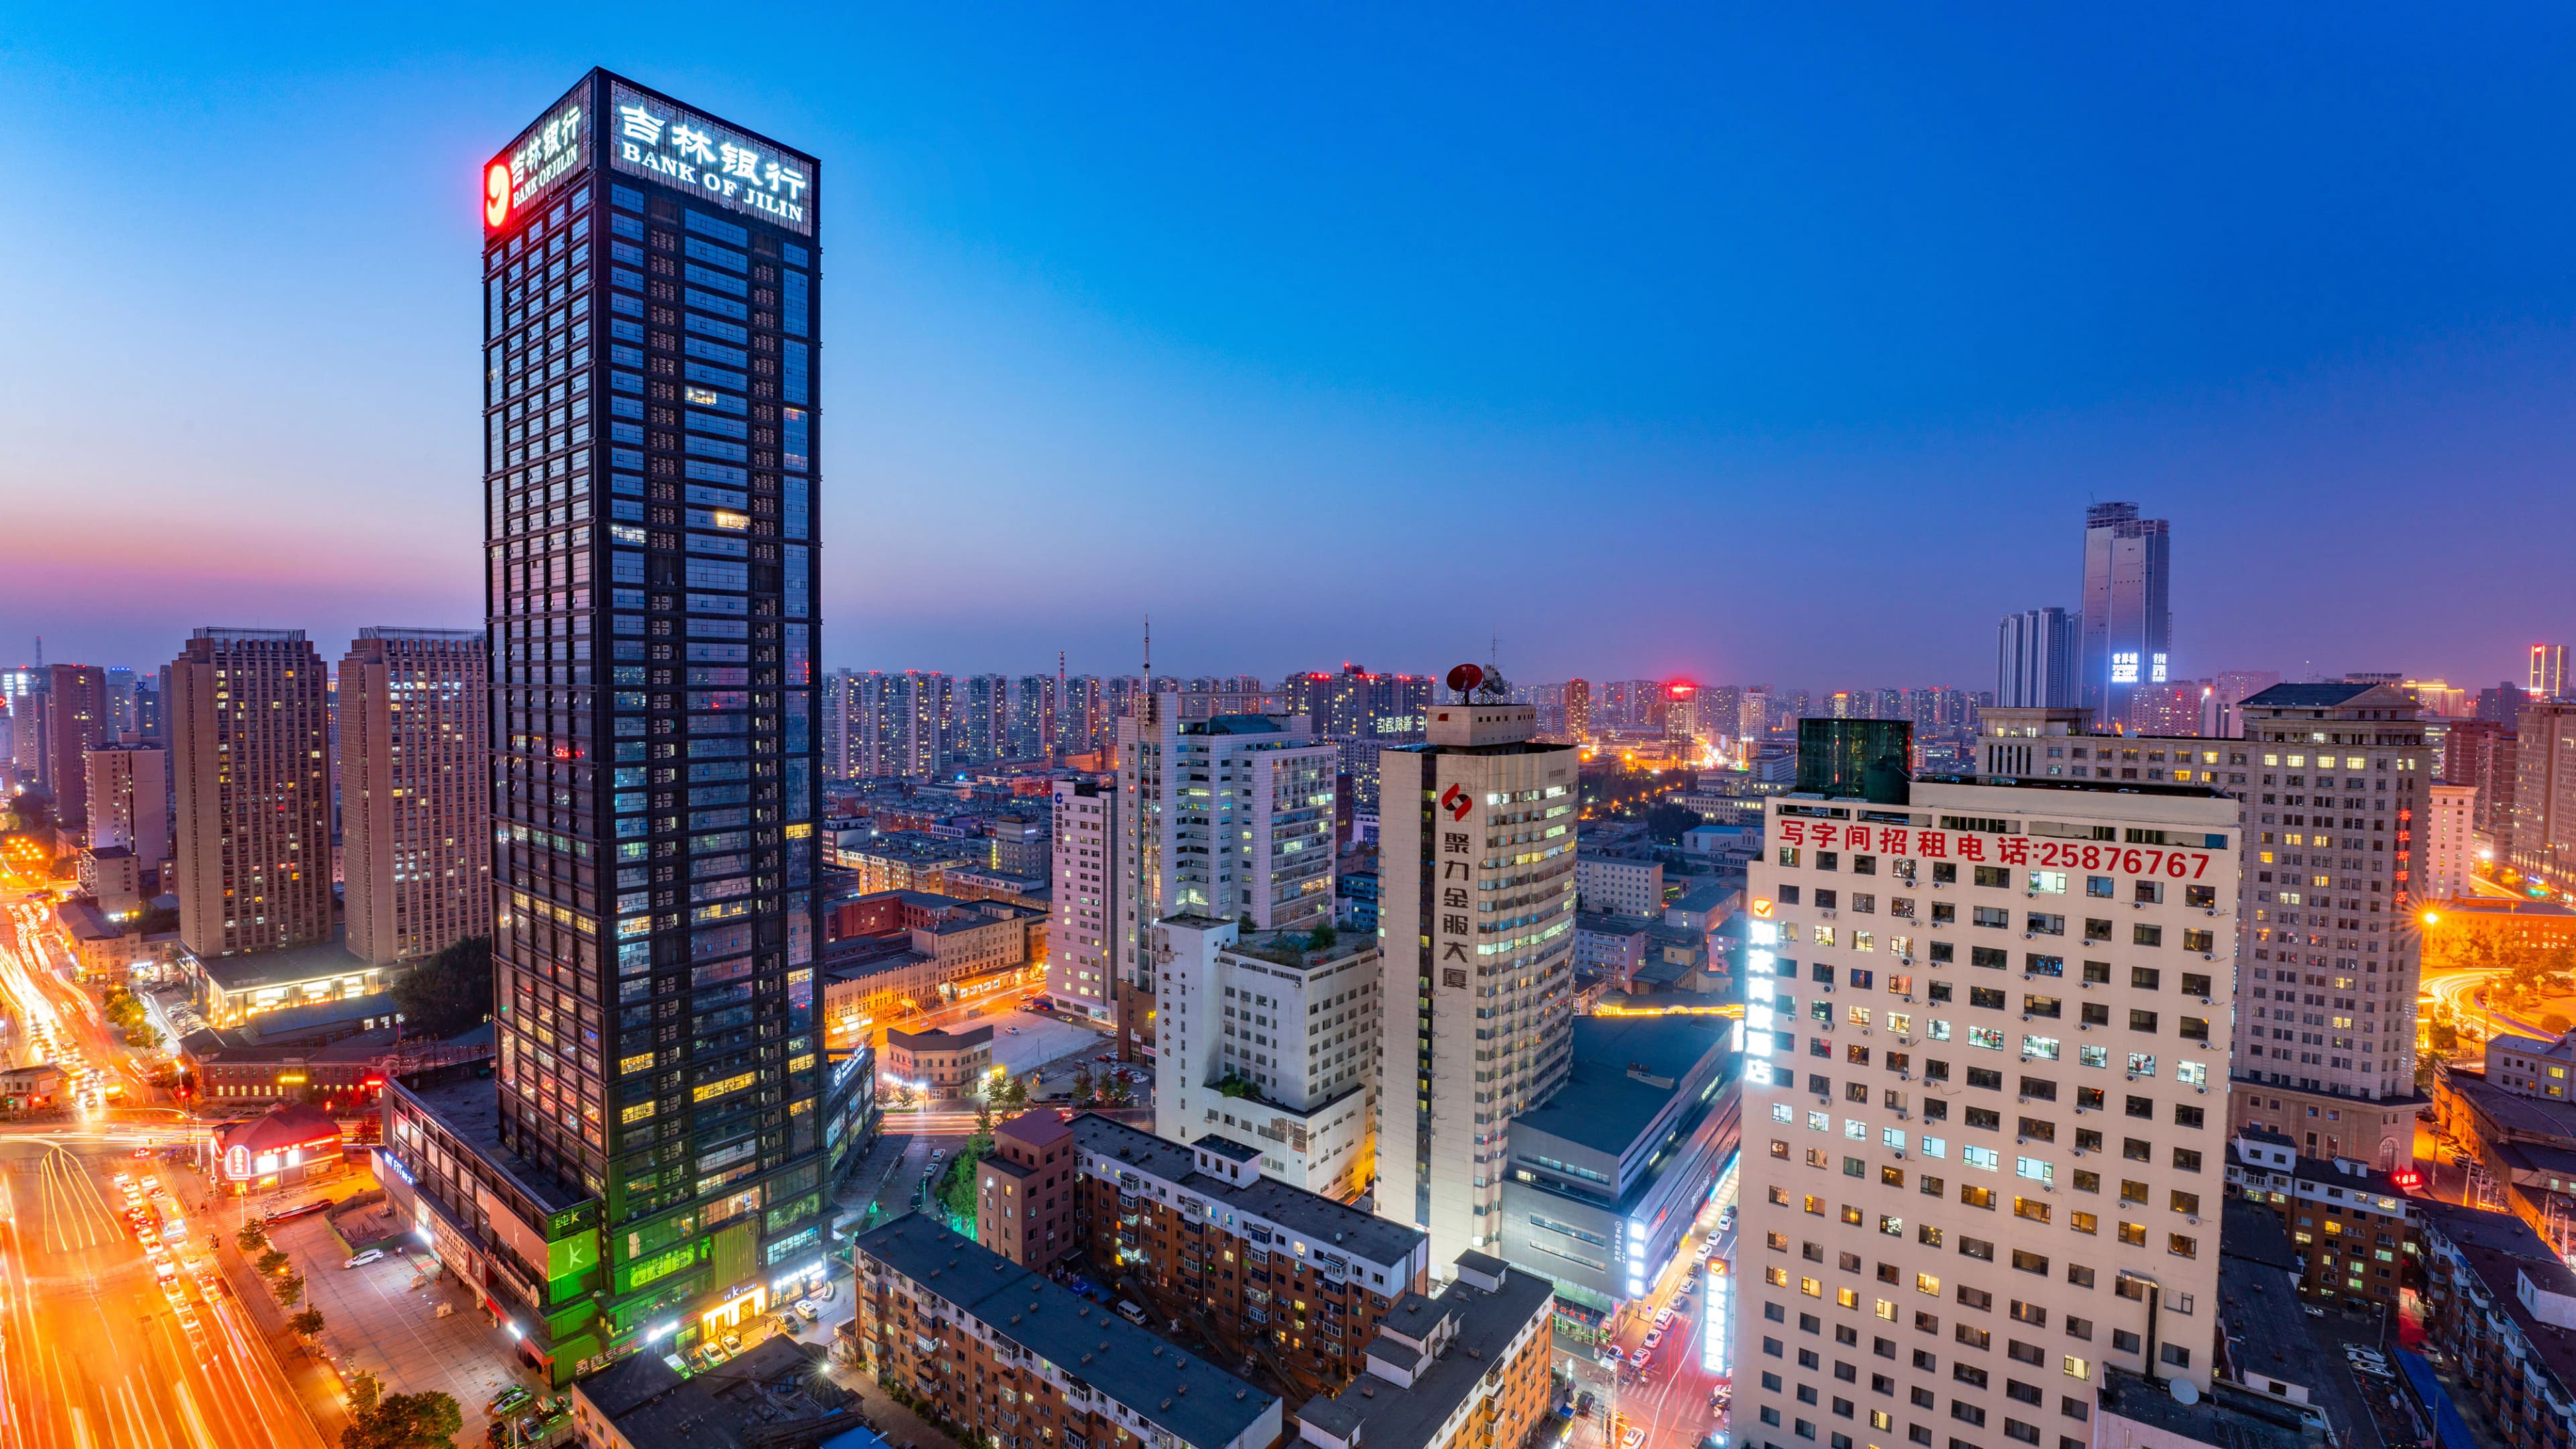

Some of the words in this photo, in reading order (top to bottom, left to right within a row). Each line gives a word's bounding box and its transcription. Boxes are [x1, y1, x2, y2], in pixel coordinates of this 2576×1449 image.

[511, 106, 581, 189] 吉林银行
[513, 182, 538, 209] BANK
[539, 167, 551, 187] OF
[551, 144, 578, 180] JILIN
[620, 105, 806, 200] 吉林银行
[622, 141, 696, 185] BANK
[704, 170, 738, 197] OF
[743, 187, 804, 223] JILIN
[1442, 832, 1470, 990] 聚力金服大厦
